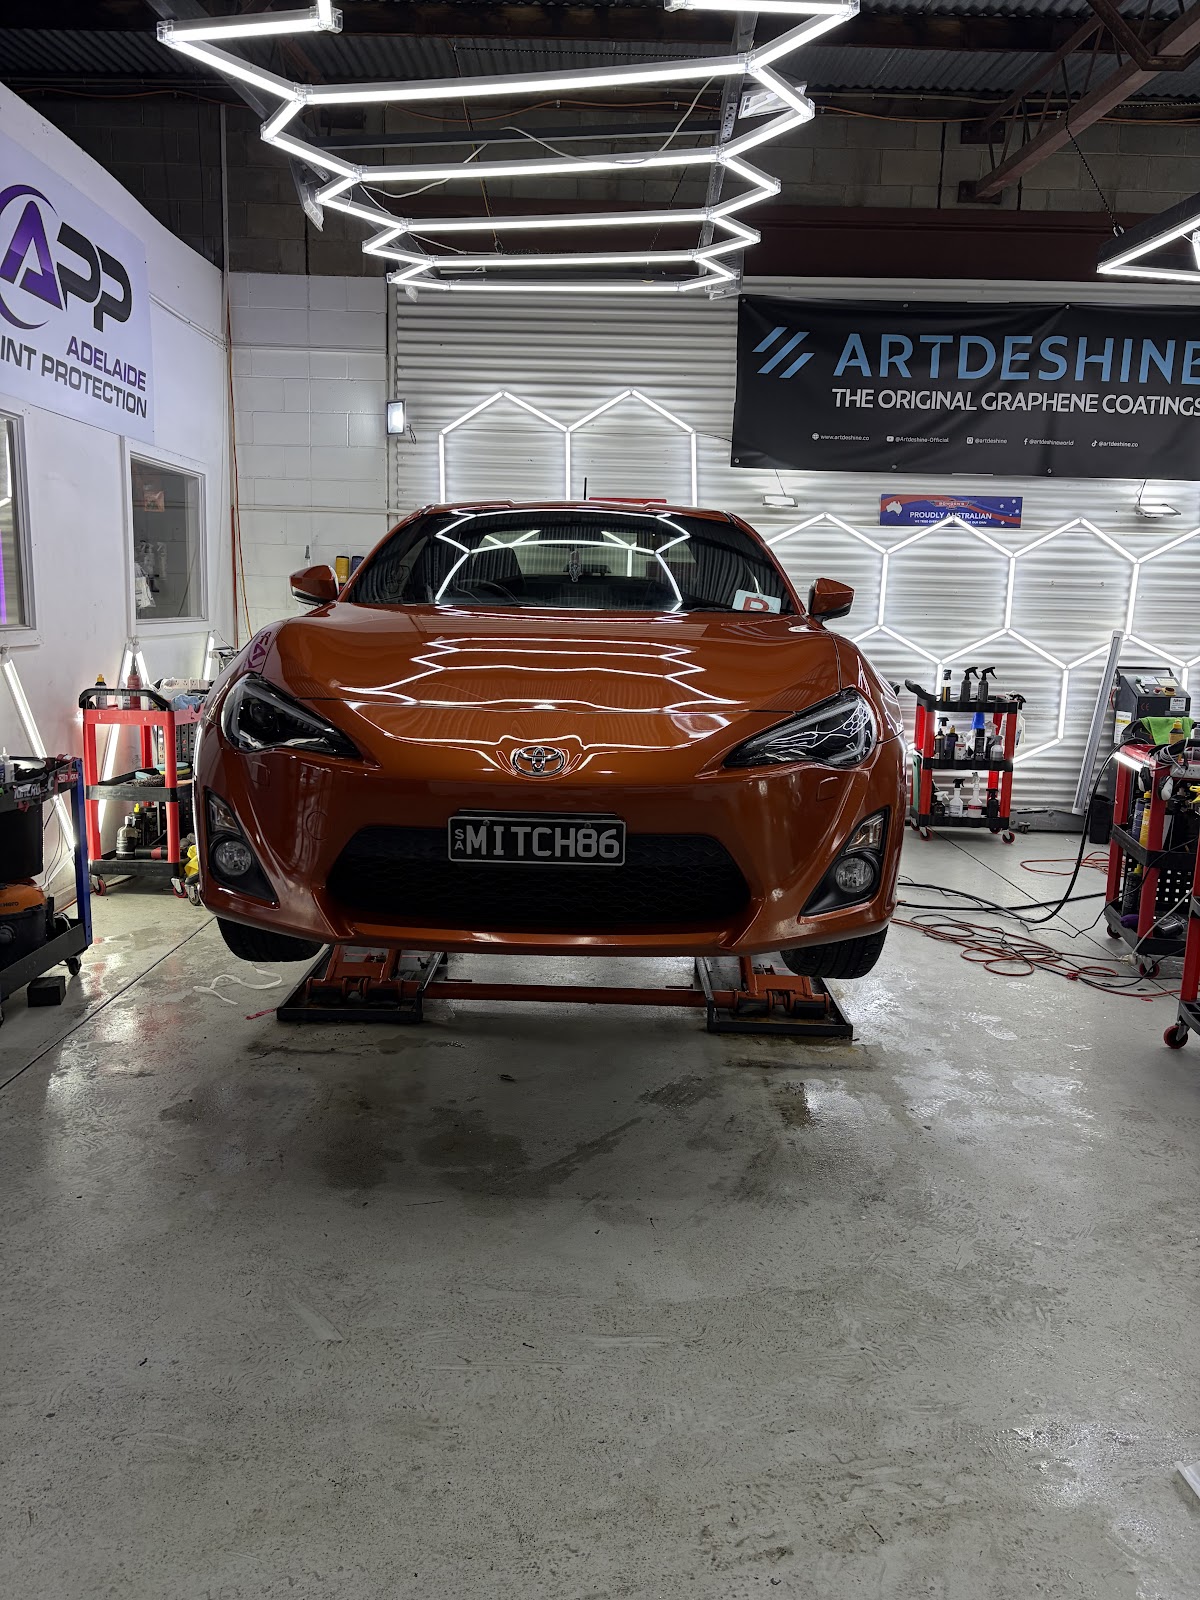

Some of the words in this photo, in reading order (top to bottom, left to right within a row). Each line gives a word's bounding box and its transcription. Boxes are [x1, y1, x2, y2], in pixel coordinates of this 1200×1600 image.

[66, 336, 146, 391] ADELAIDE
[833, 333, 1200, 385] ARTDESHINE
[41, 353, 147, 418] PROTECTION
[832, 388, 874, 409] THE
[878, 389, 977, 411] ORIGINAL
[981, 391, 1098, 414] GRAPHENE
[466, 825, 620, 858] MITCH86
